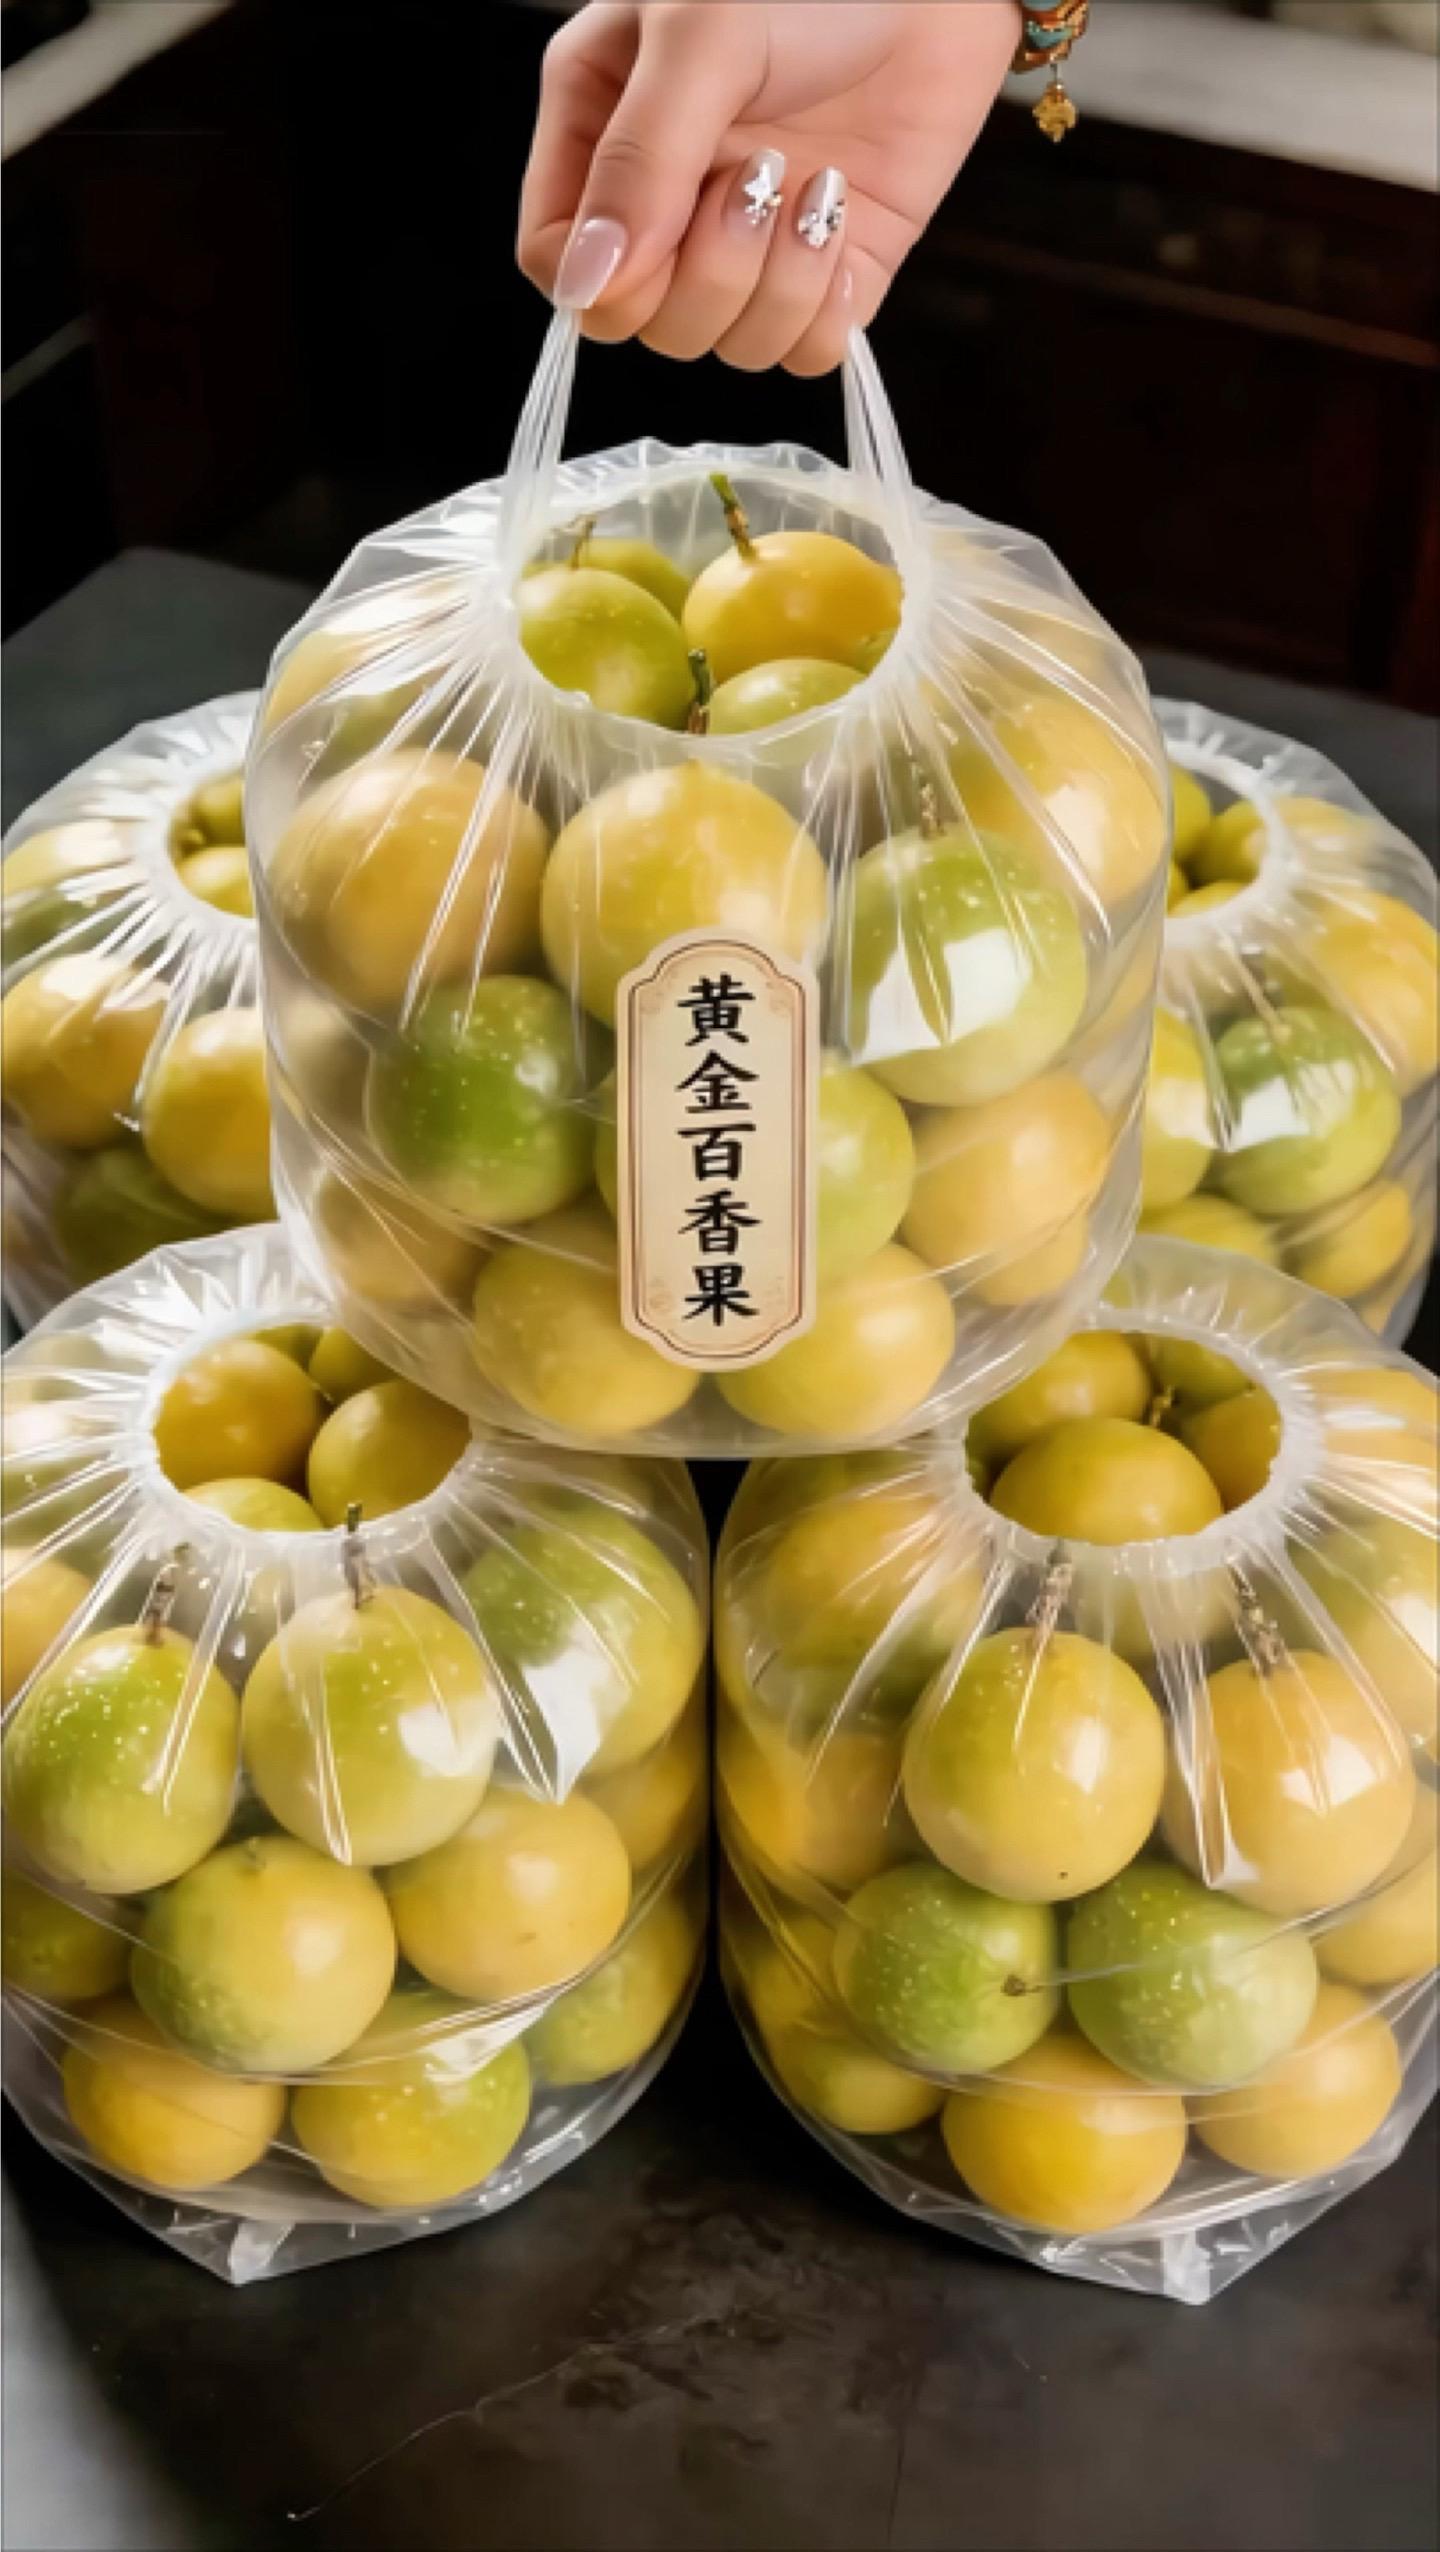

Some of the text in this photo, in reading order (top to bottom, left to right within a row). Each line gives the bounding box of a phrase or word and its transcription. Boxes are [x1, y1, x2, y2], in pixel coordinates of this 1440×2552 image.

[676, 973, 761, 1327] 黄金百香果
